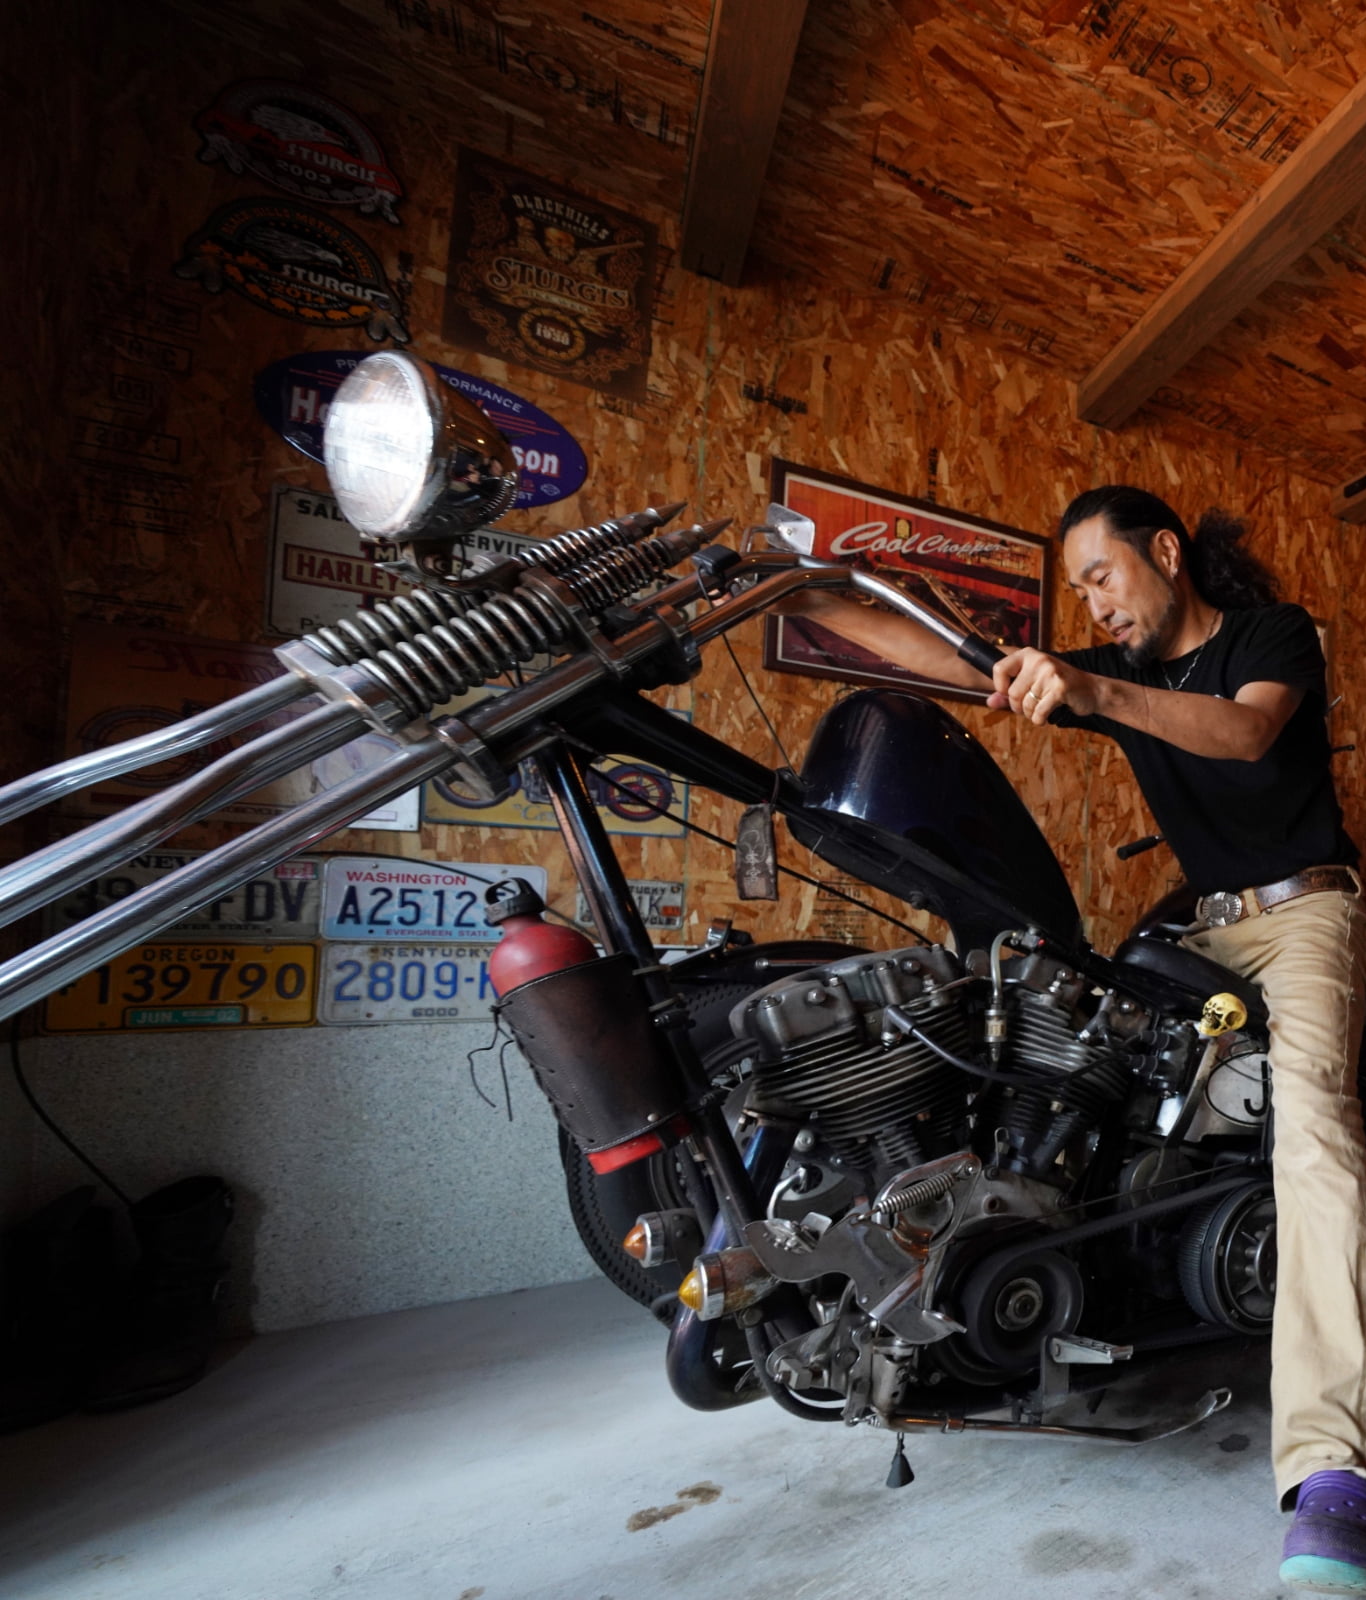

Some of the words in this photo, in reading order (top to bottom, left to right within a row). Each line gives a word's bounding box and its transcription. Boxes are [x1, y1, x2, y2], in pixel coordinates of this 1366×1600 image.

[287, 143, 377, 182] STURGIS
[281, 264, 381, 302] STURGIS
[486, 256, 630, 309] STURGIS
[296, 499, 344, 522] SAL
[830, 521, 914, 555] Cool
[297, 554, 414, 592] HARLEY-
[301, 617, 341, 635] Par
[347, 871, 467, 885] WASHINGTON
[386, 928, 452, 937] EVERGREEN
[458, 929, 489, 937] STATE
[143, 949, 236, 962] OREGON
[382, 946, 494, 959] KENTUCKY
[94, 963, 306, 1004] 139790
[412, 1007, 458, 1017] 6000
